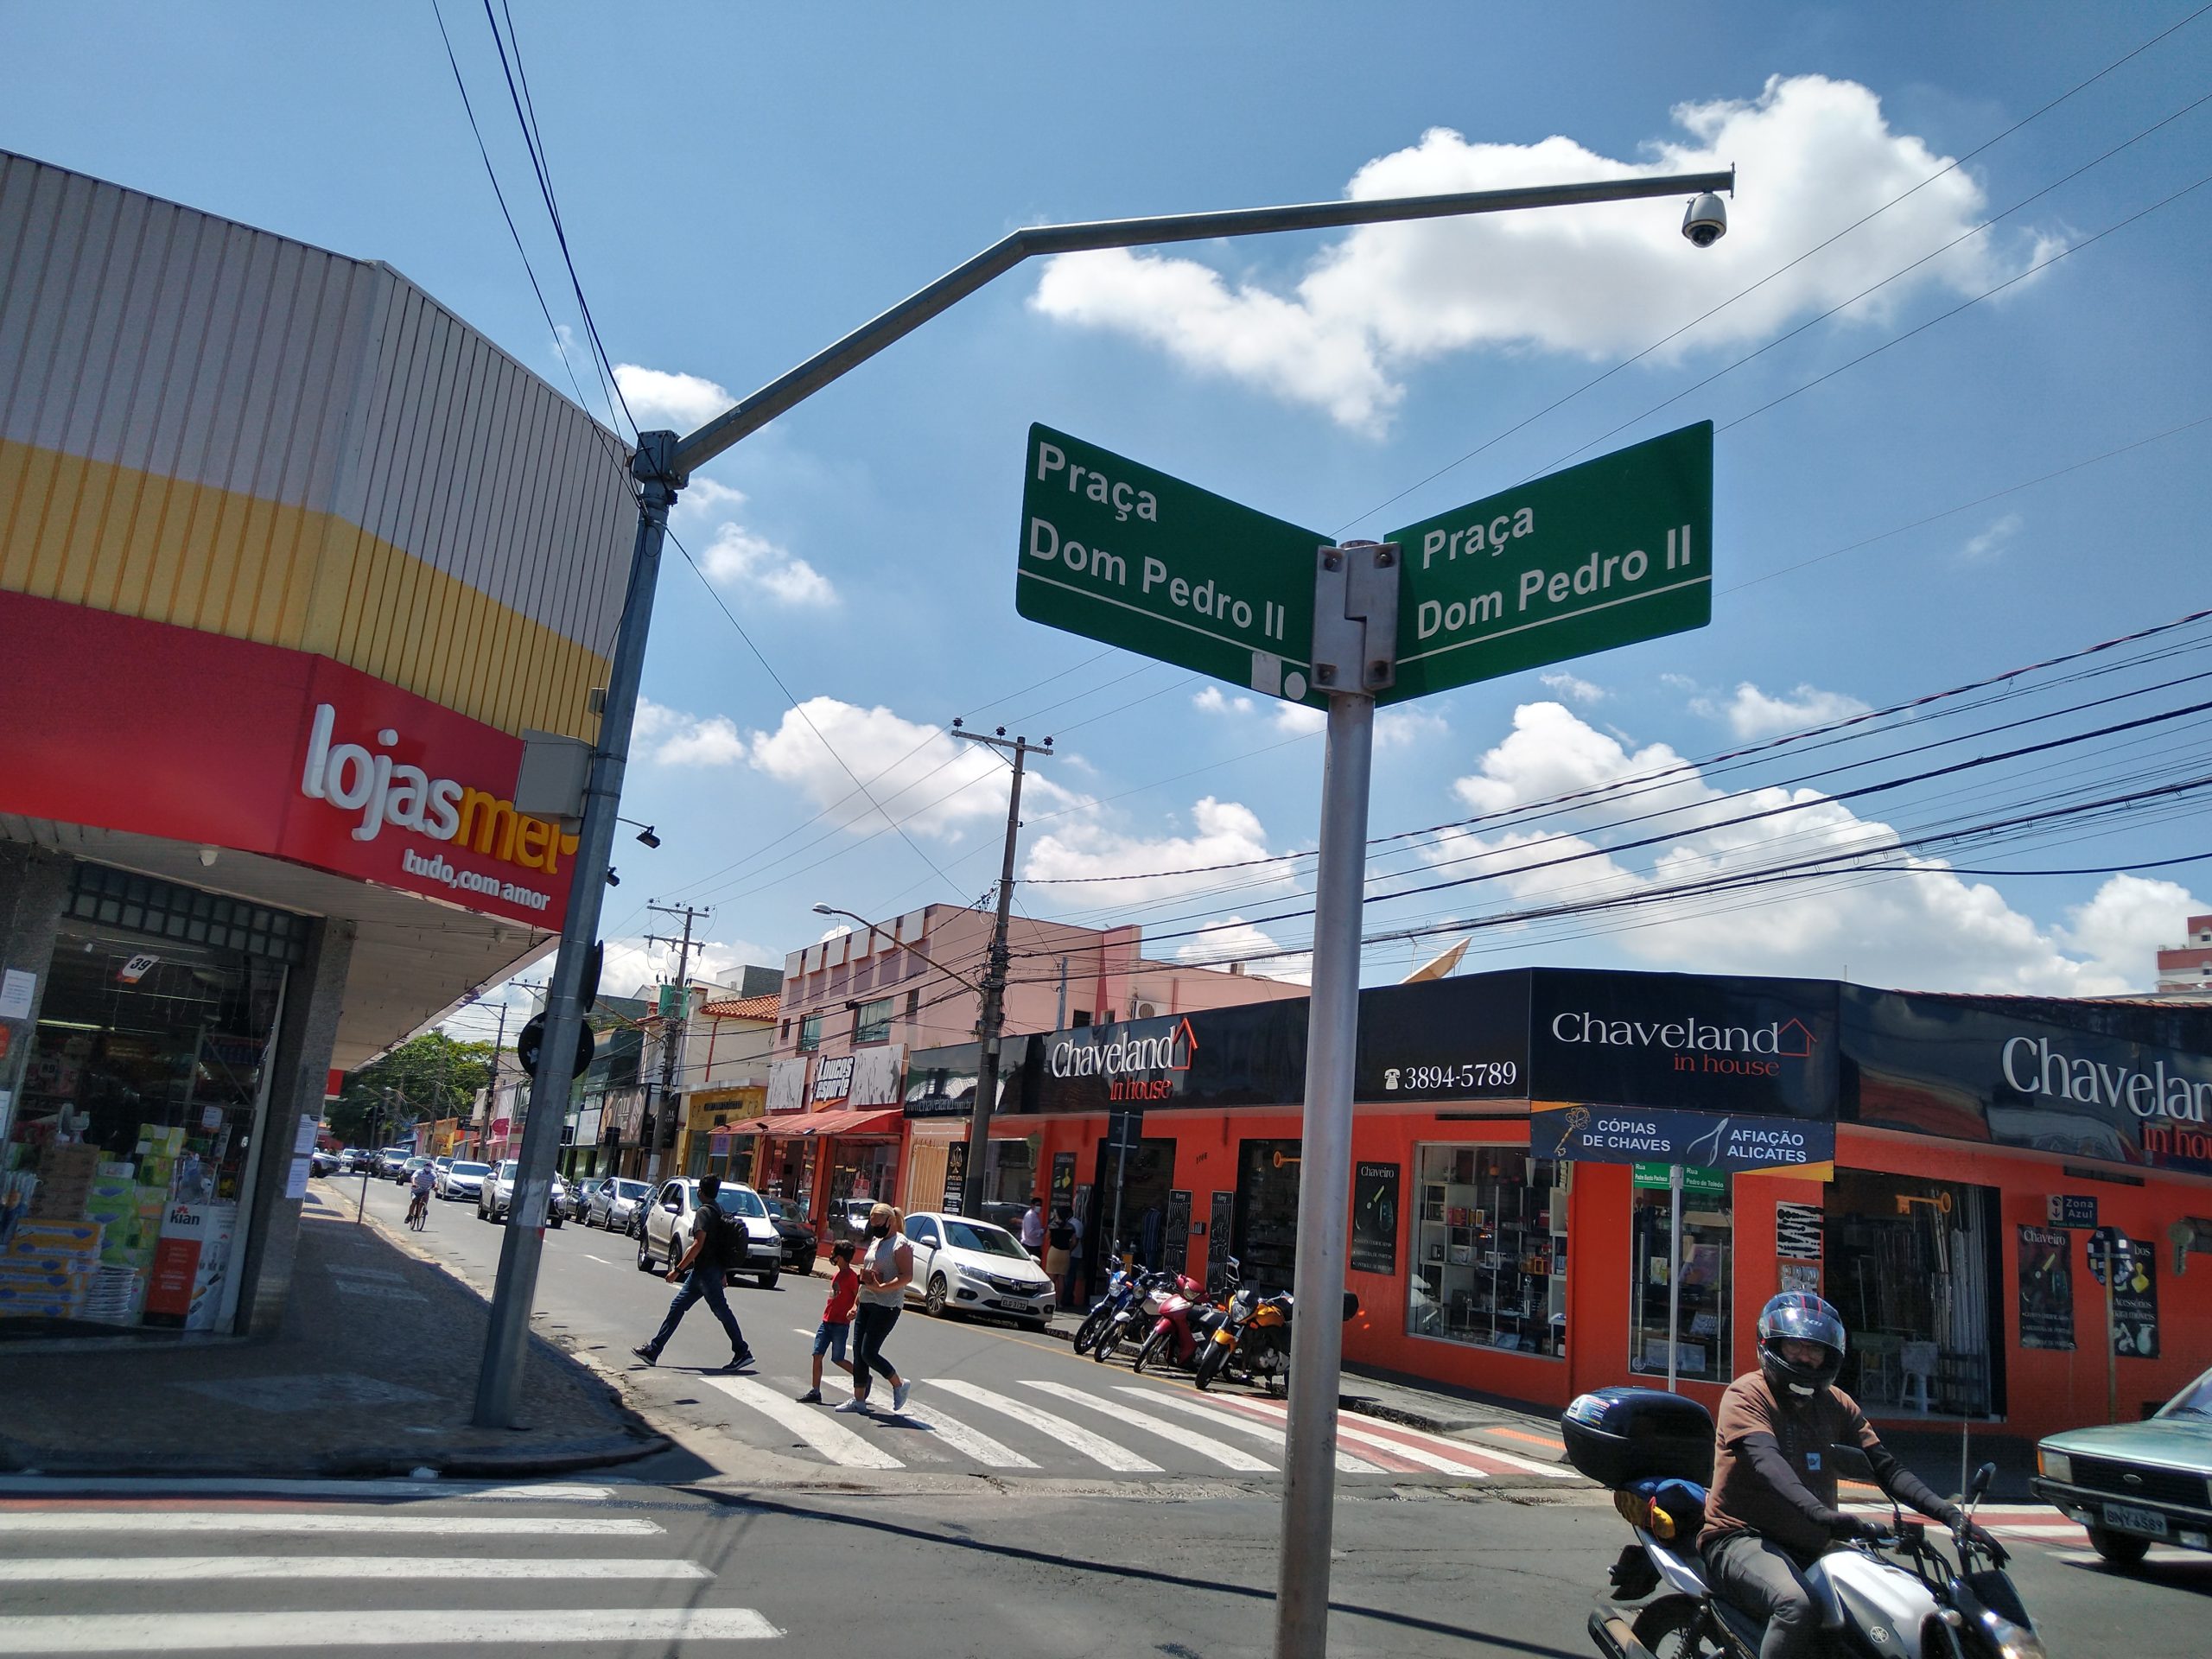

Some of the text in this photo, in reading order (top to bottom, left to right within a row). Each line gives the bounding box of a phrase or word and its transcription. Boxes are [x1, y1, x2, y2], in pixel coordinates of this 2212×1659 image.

[1037, 441, 1158, 523] Praça
[1422, 507, 1535, 569] Praça
[1029, 517, 1285, 640] Dom Pedro II
[1417, 524, 1691, 640] Dom Pedro II
[129, 957, 153, 971] 39
[1552, 1012, 1780, 1054] Chaveland
[1052, 1025, 1176, 1078] Chaveland
[817, 1056, 855, 1081] Loucos
[1403, 1061, 1516, 1091] 3894-5789
[1674, 1052, 1780, 1077] in house
[815, 1075, 850, 1102] esporte
[1109, 1076, 1173, 1101] in house
[1597, 1119, 1656, 1136] CÓPIAS
[1730, 1129, 1805, 1148] AFIAÇÃO
[2143, 1122, 2169, 1154] in
[1583, 1134, 1671, 1153] DE CHAVES
[1727, 1145, 1808, 1163] ALICATES
[1361, 1166, 1395, 1179] Chaveiro
[1686, 1178, 1700, 1186] Pedro
[1707, 1179, 1725, 1188] Toledo
[2066, 1198, 2094, 1209] Zona
[2068, 1209, 2093, 1219] Azul
[170, 1210, 200, 1225] kian
[2023, 1229, 2066, 1246] Chaveiro
